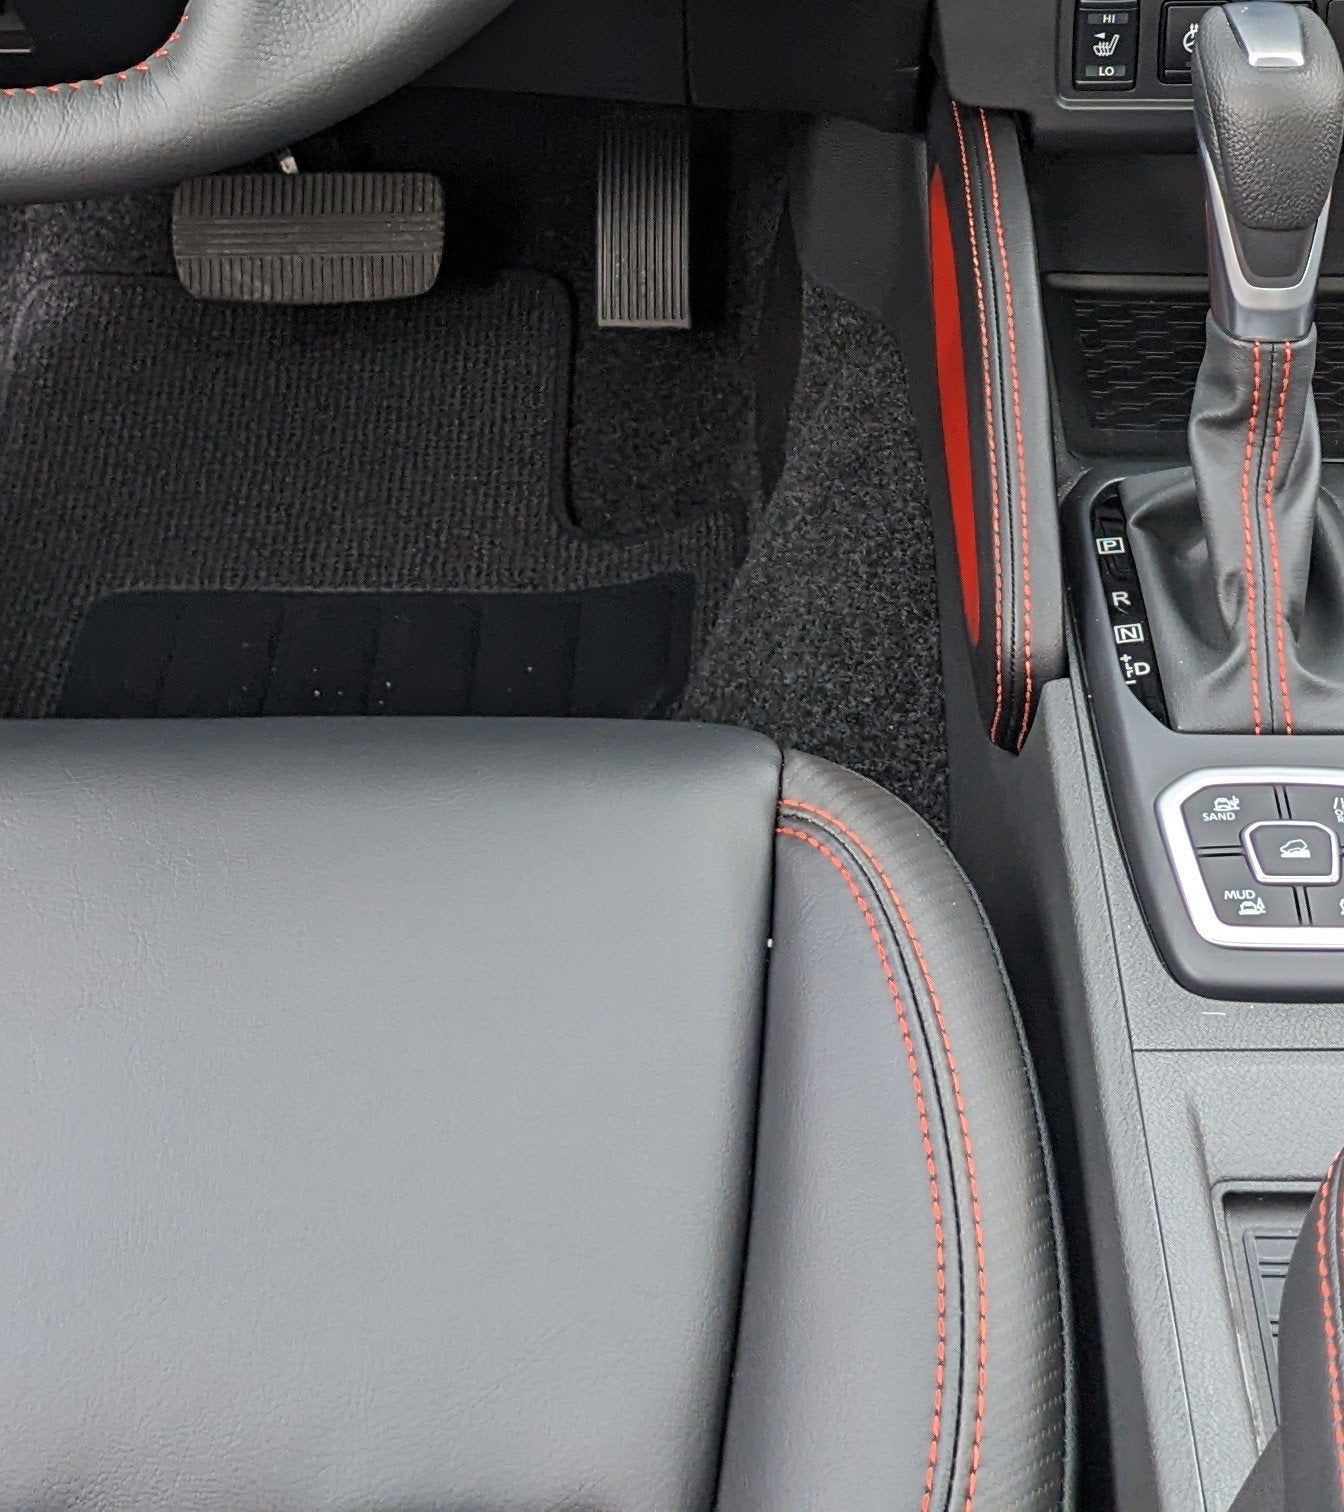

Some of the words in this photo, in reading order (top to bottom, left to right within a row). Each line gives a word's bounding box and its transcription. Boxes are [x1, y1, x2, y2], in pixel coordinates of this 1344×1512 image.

[1102, 14, 1116, 24] HI
[1098, 66, 1114, 76] LO
[1103, 540, 1117, 552] P
[1111, 591, 1131, 607] R
[1119, 626, 1137, 640] N
[1133, 661, 1151, 676] D
[1202, 810, 1236, 822] SAND
[1223, 889, 1256, 900] MUD
